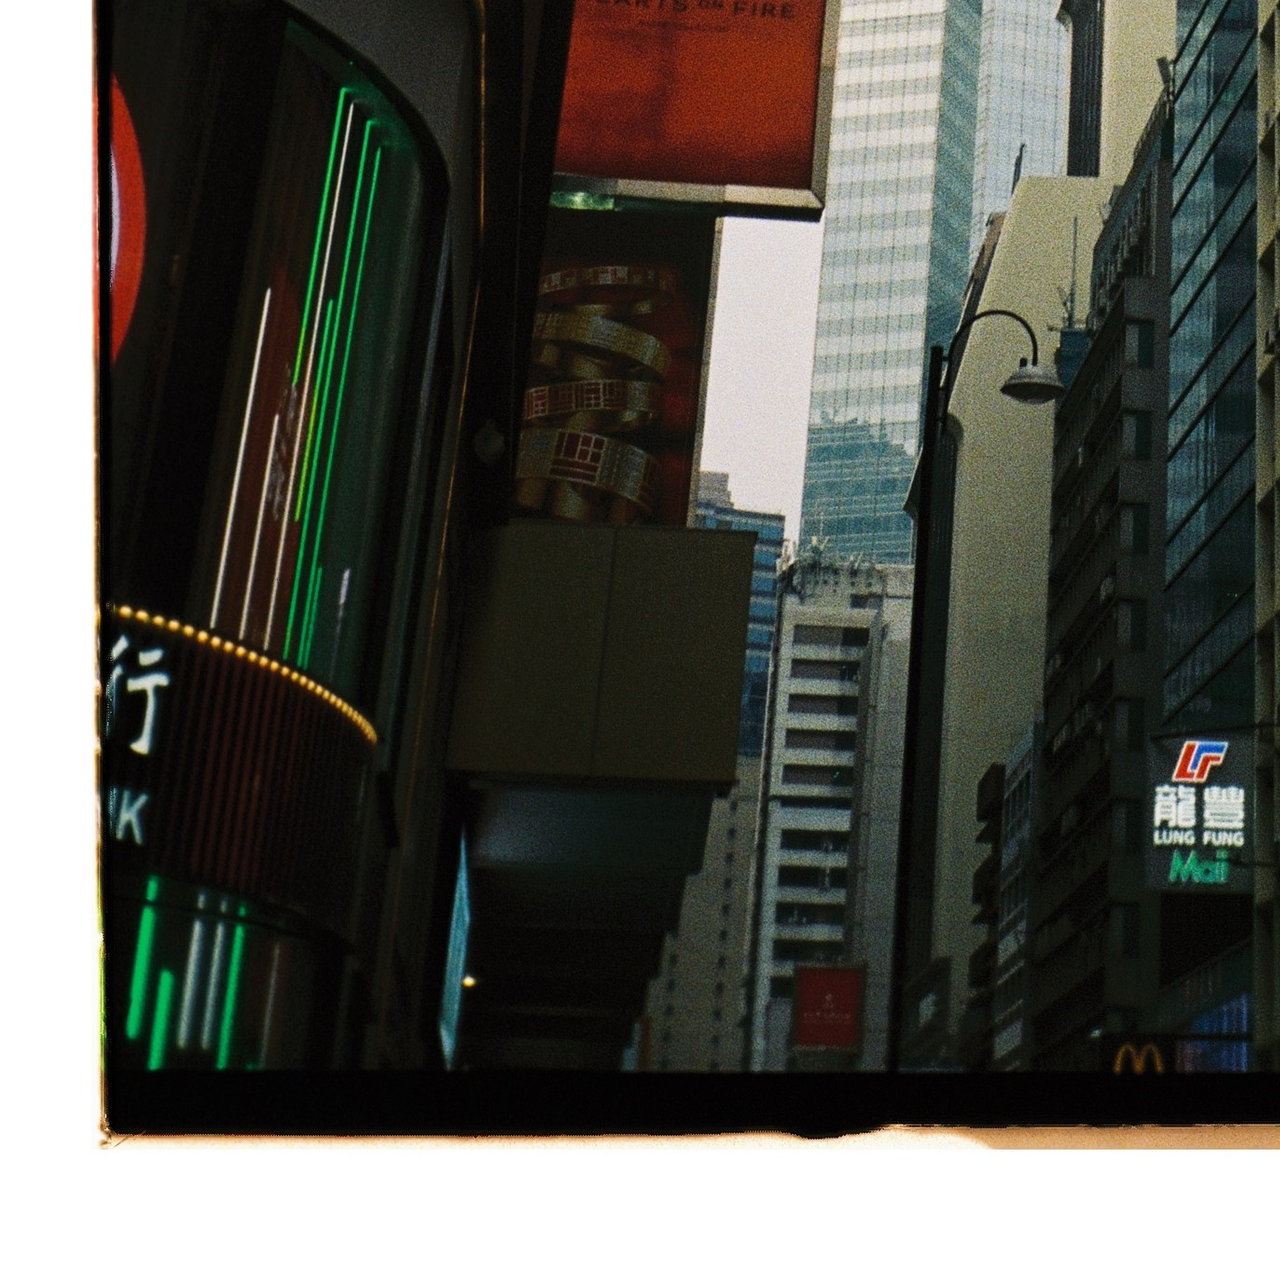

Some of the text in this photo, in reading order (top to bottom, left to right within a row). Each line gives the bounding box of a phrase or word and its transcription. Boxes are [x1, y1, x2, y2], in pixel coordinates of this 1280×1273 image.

[697, 0, 723, 10] ON
[733, 1, 796, 20] FIRE
[1153, 829, 1245, 847] LUNG FUNG
